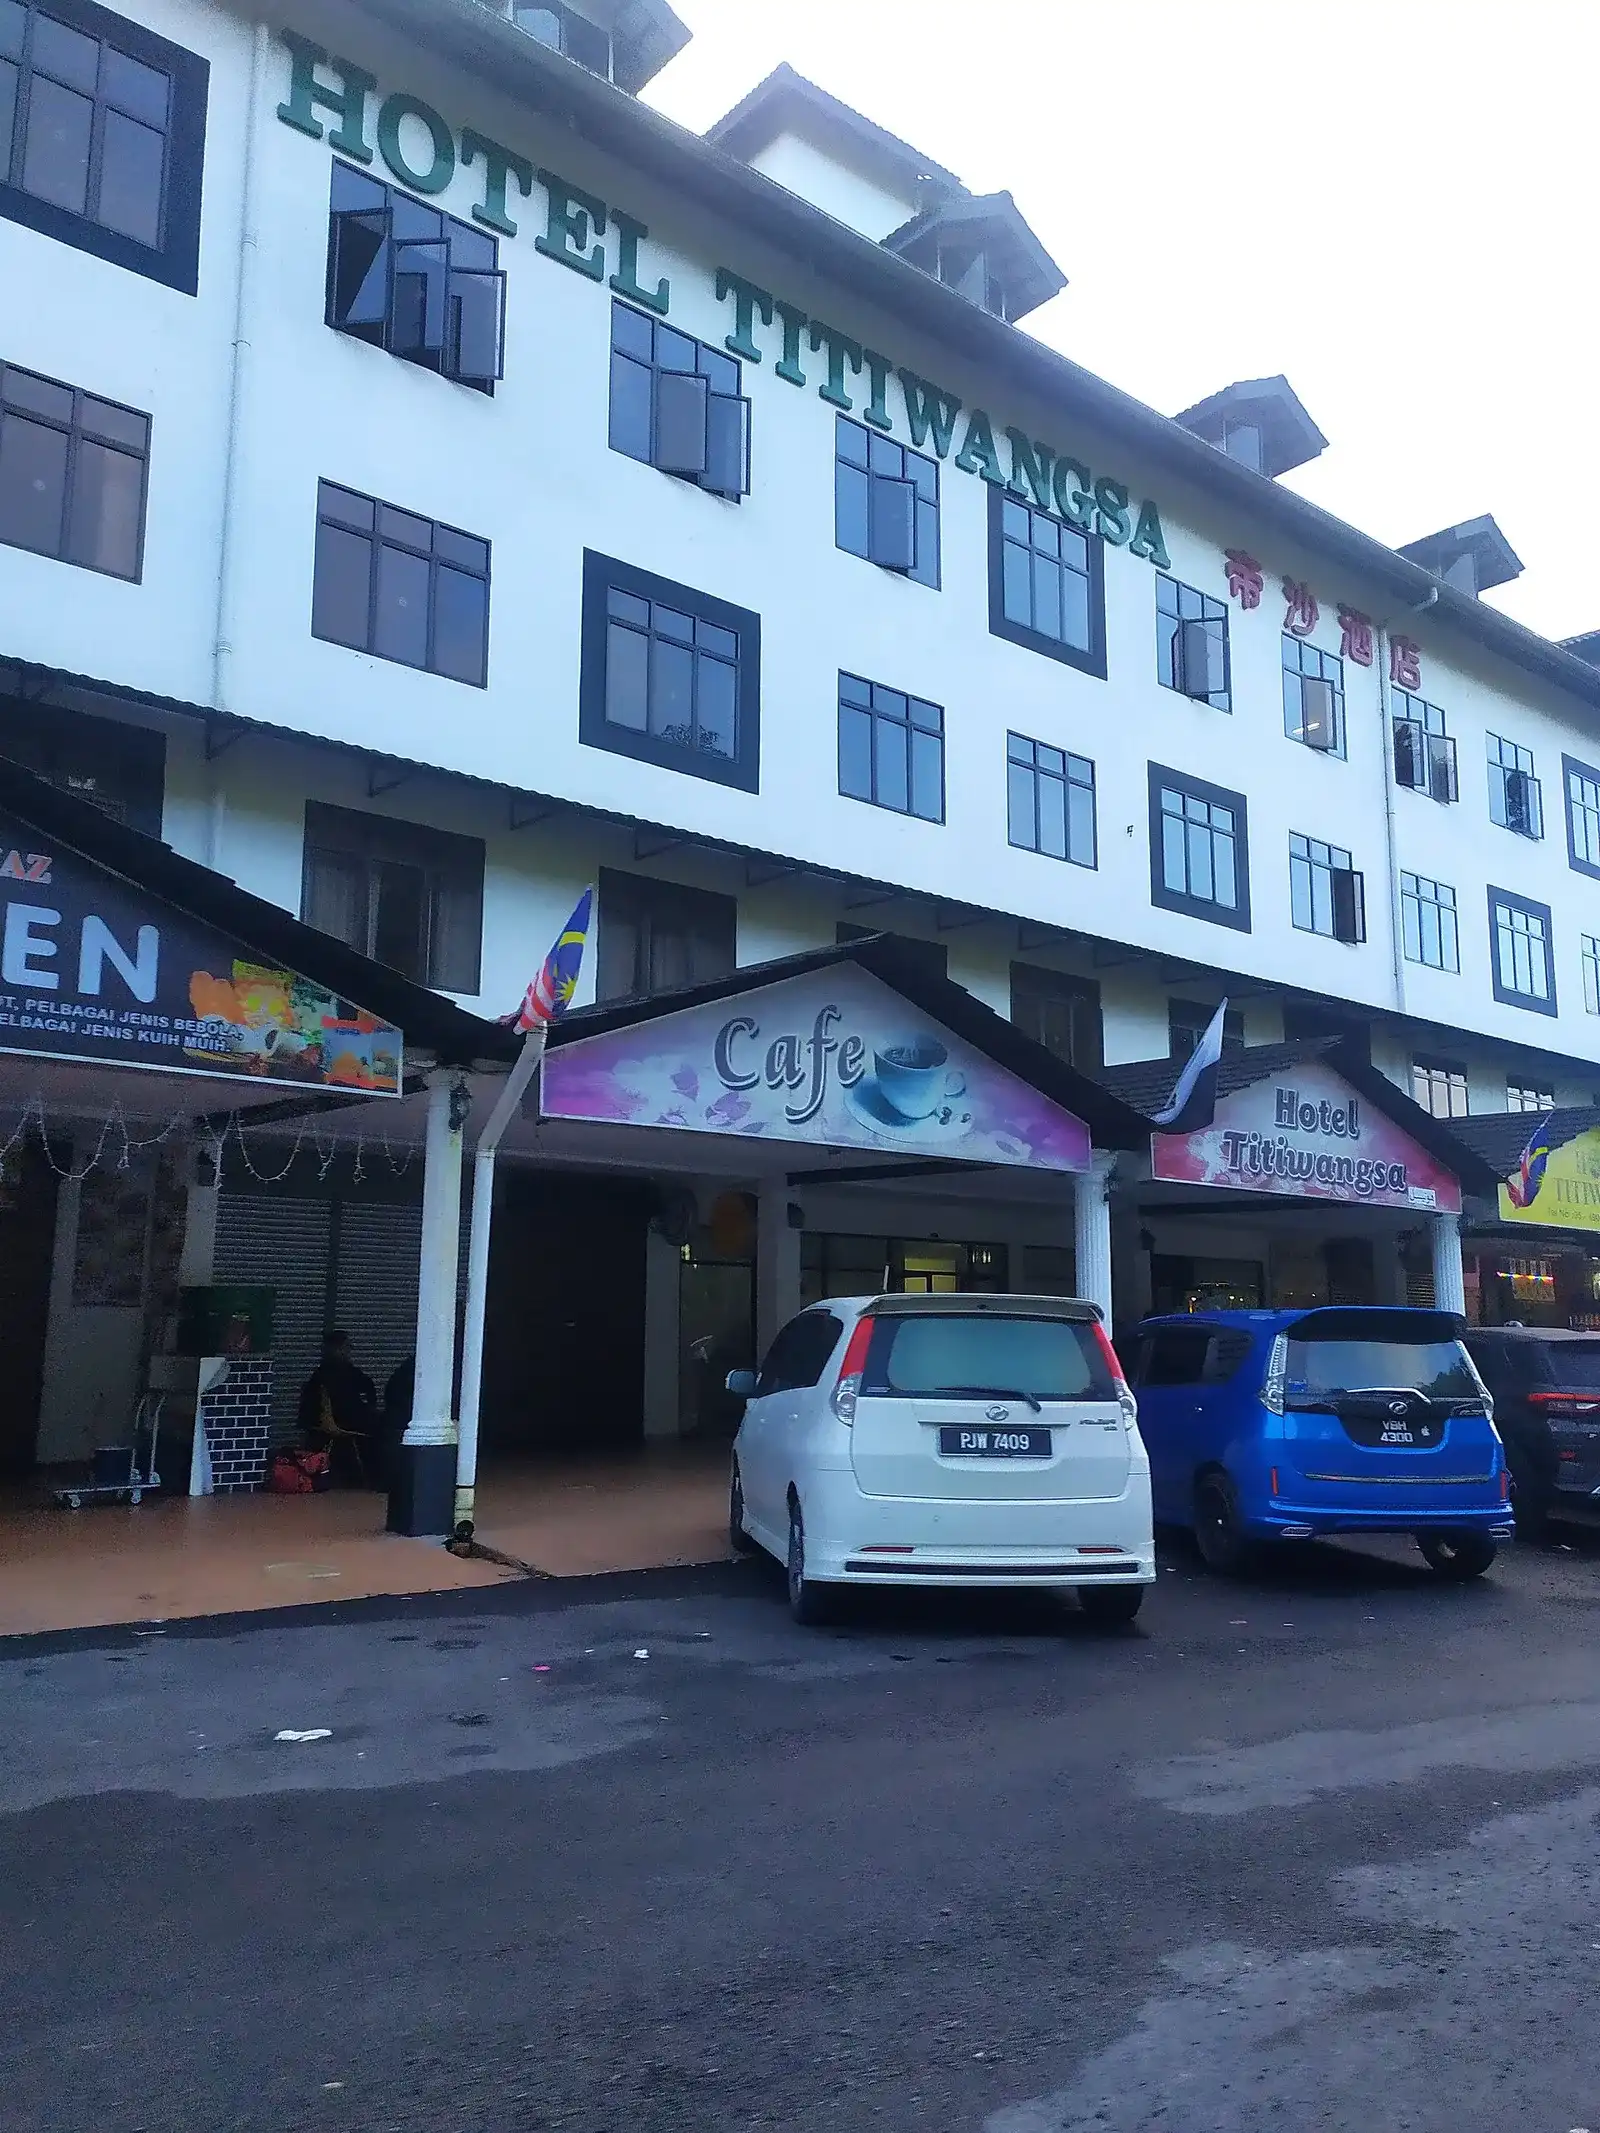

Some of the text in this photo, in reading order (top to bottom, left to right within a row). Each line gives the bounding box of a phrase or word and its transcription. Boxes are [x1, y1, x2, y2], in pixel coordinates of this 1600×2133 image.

[277, 27, 1172, 570] HOTEL TITIWANGSA
[1224, 548, 1421, 690] 帝沙酒店
[0, 848, 53, 885] AZ
[25, 998, 116, 1021] PELBAGAI
[119, 1011, 169, 1028] JENIS
[173, 1018, 245, 1041] BEBOLA,
[80, 1023, 134, 1041] JENIS
[137, 1030, 180, 1046] KUIH
[714, 1004, 866, 1124] Cafe
[1274, 1086, 1359, 1139] Hotel
[1223, 1130, 1408, 1195] Titiwangsa
[960, 1432, 1030, 1450] PJW 7409
[1380, 1431, 1414, 1443] 4300
